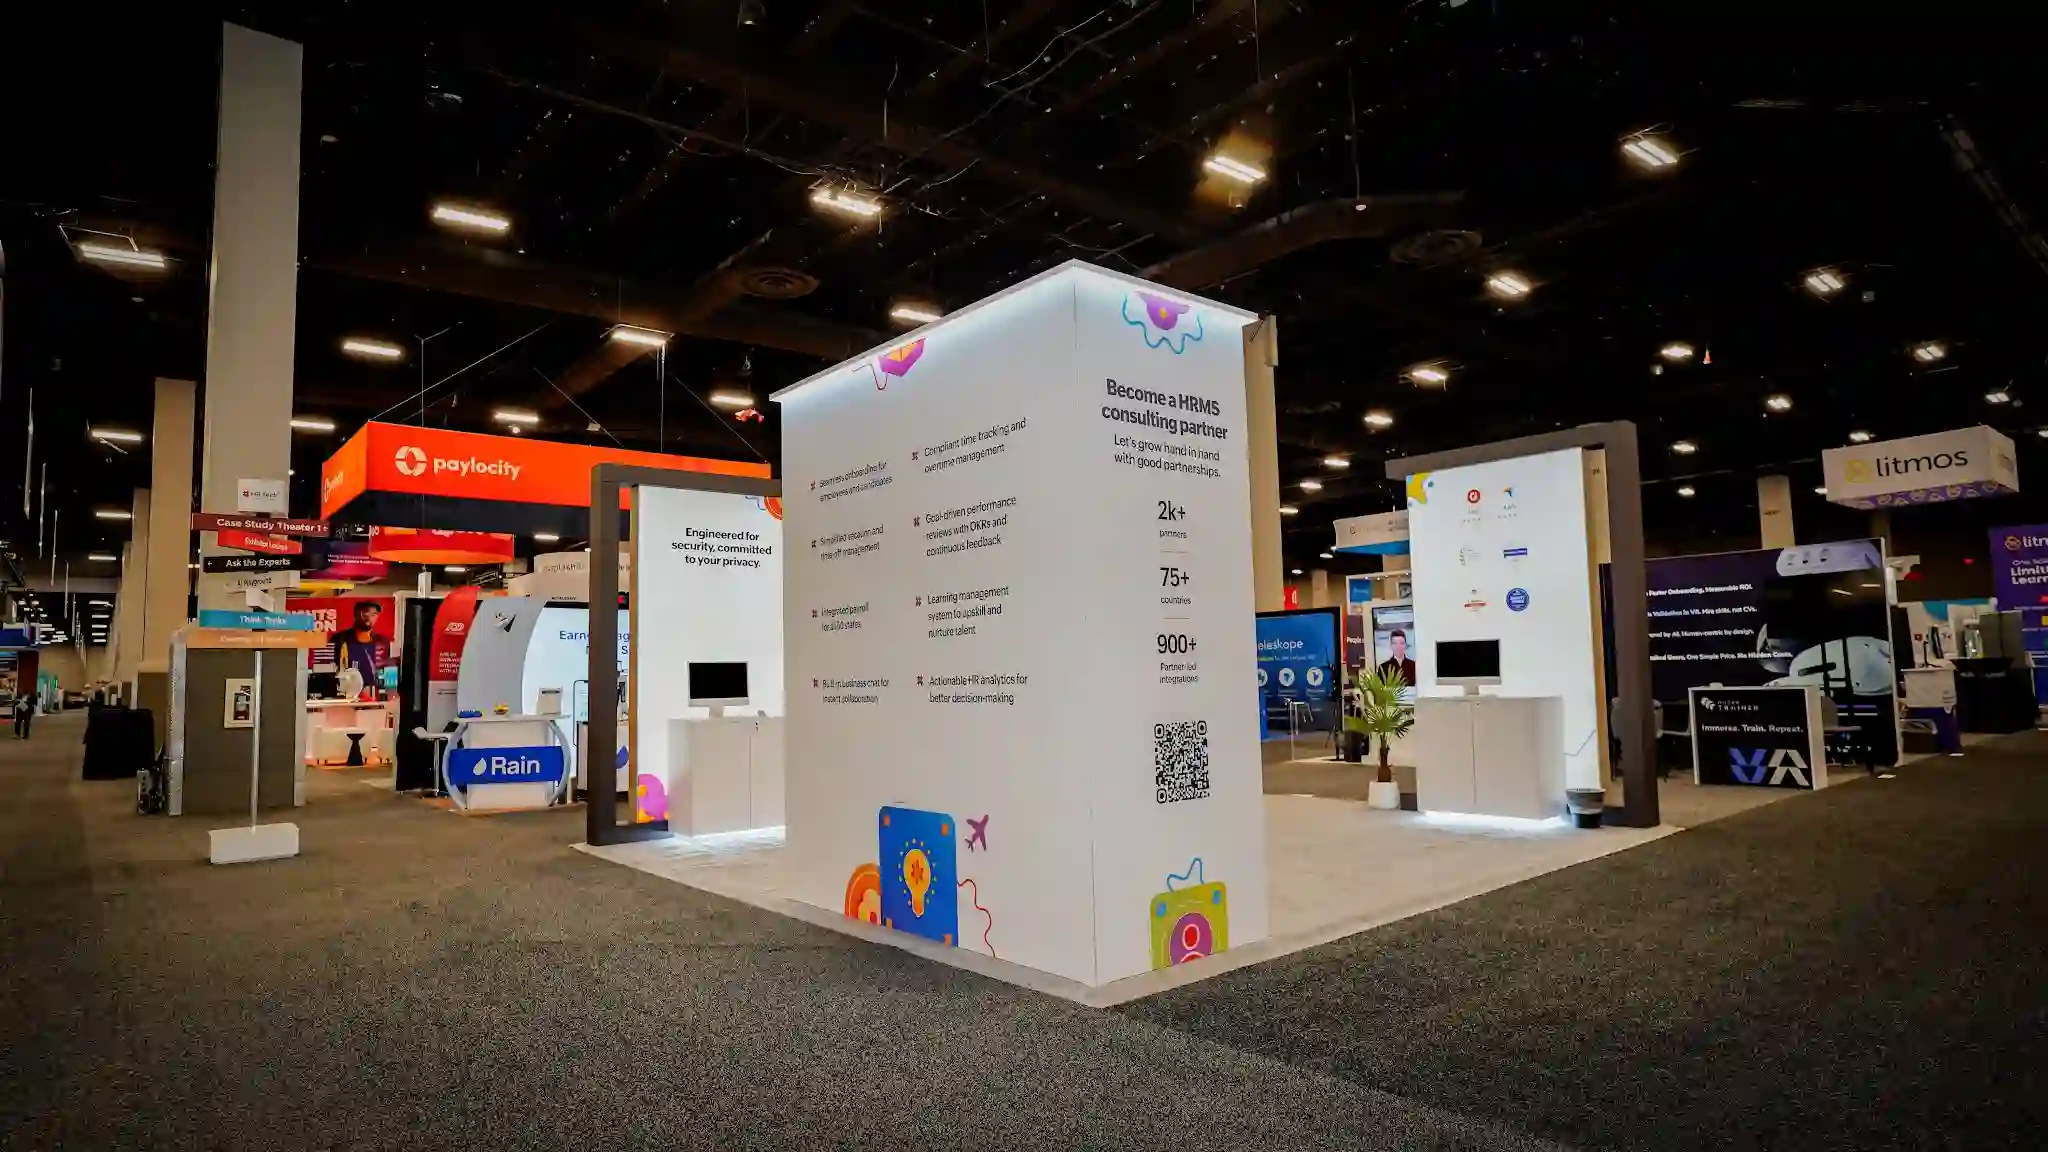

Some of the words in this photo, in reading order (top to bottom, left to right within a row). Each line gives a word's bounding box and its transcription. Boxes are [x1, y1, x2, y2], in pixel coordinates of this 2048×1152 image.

[1106, 378, 1166, 405] Become
[1168, 395, 1177, 408] a
[1179, 393, 1220, 416] HRMS
[1101, 406, 1177, 434] consulting
[1180, 420, 1228, 439] partner
[924, 440, 960, 456] Compliant
[961, 435, 977, 447] time
[978, 425, 1010, 441] tracking
[1010, 417, 1027, 432] and
[1114, 434, 1136, 448] Let's
[1138, 440, 1162, 452] grow
[1164, 442, 1187, 457] hand
[1188, 445, 1197, 458] in
[1198, 447, 1220, 461] hand
[924, 457, 955, 473] overtime
[956, 443, 1005, 465] management
[1114, 452, 1136, 465] with
[1137, 457, 1162, 469] good
[1163, 460, 1221, 478] partnerships.
[1876, 450, 1969, 477] litmos
[433, 456, 521, 480] paylocity
[820, 487, 848, 502] employees
[849, 484, 860, 495] and
[860, 476, 893, 491] candidates
[926, 507, 966, 524] Goal-driven
[966, 496, 1016, 516] performance
[1157, 500, 1186, 520] 2k+
[217, 518, 243, 527] Case
[245, 519, 274, 531] Study
[278, 521, 316, 532] Theater
[685, 527, 744, 540] Engineered
[746, 531, 760, 541] for
[872, 524, 884, 536] and
[926, 527, 952, 540] reviews
[953, 523, 969, 535] with
[970, 519, 991, 532] OKRs
[992, 514, 1007, 527] and
[1159, 529, 1187, 539] partners
[672, 541, 715, 553] security,
[717, 544, 772, 555] committed
[843, 541, 880, 556] management
[926, 543, 966, 557] continuous
[966, 534, 1002, 550] feedback
[226, 559, 241, 567] Ask
[243, 558, 256, 567] the
[259, 558, 291, 568] Experts
[685, 555, 696, 564] to
[698, 557, 721, 566] your
[723, 557, 761, 568] privacy.
[1160, 567, 1190, 587] 75+
[927, 592, 958, 604] Learning
[959, 586, 1009, 601] management
[1160, 596, 1191, 605] countries
[928, 610, 953, 622] system
[953, 608, 961, 619] to
[962, 605, 986, 620] upskill
[987, 604, 1002, 616] and
[928, 628, 954, 639] nurture
[955, 624, 976, 635] talent
[1157, 634, 1197, 654] 900+
[929, 674, 967, 686] Actionable
[968, 674, 979, 684] HR
[980, 673, 1015, 686] analytics
[1016, 672, 1028, 684] for
[1159, 674, 1198, 685] integrations
[929, 692, 950, 703] better
[951, 692, 1014, 705] decision-making
[1702, 724, 1740, 732] Immerse.
[1741, 724, 1767, 732] Train.
[1768, 725, 1804, 734] Repeat.
[491, 756, 540, 775] Rain
